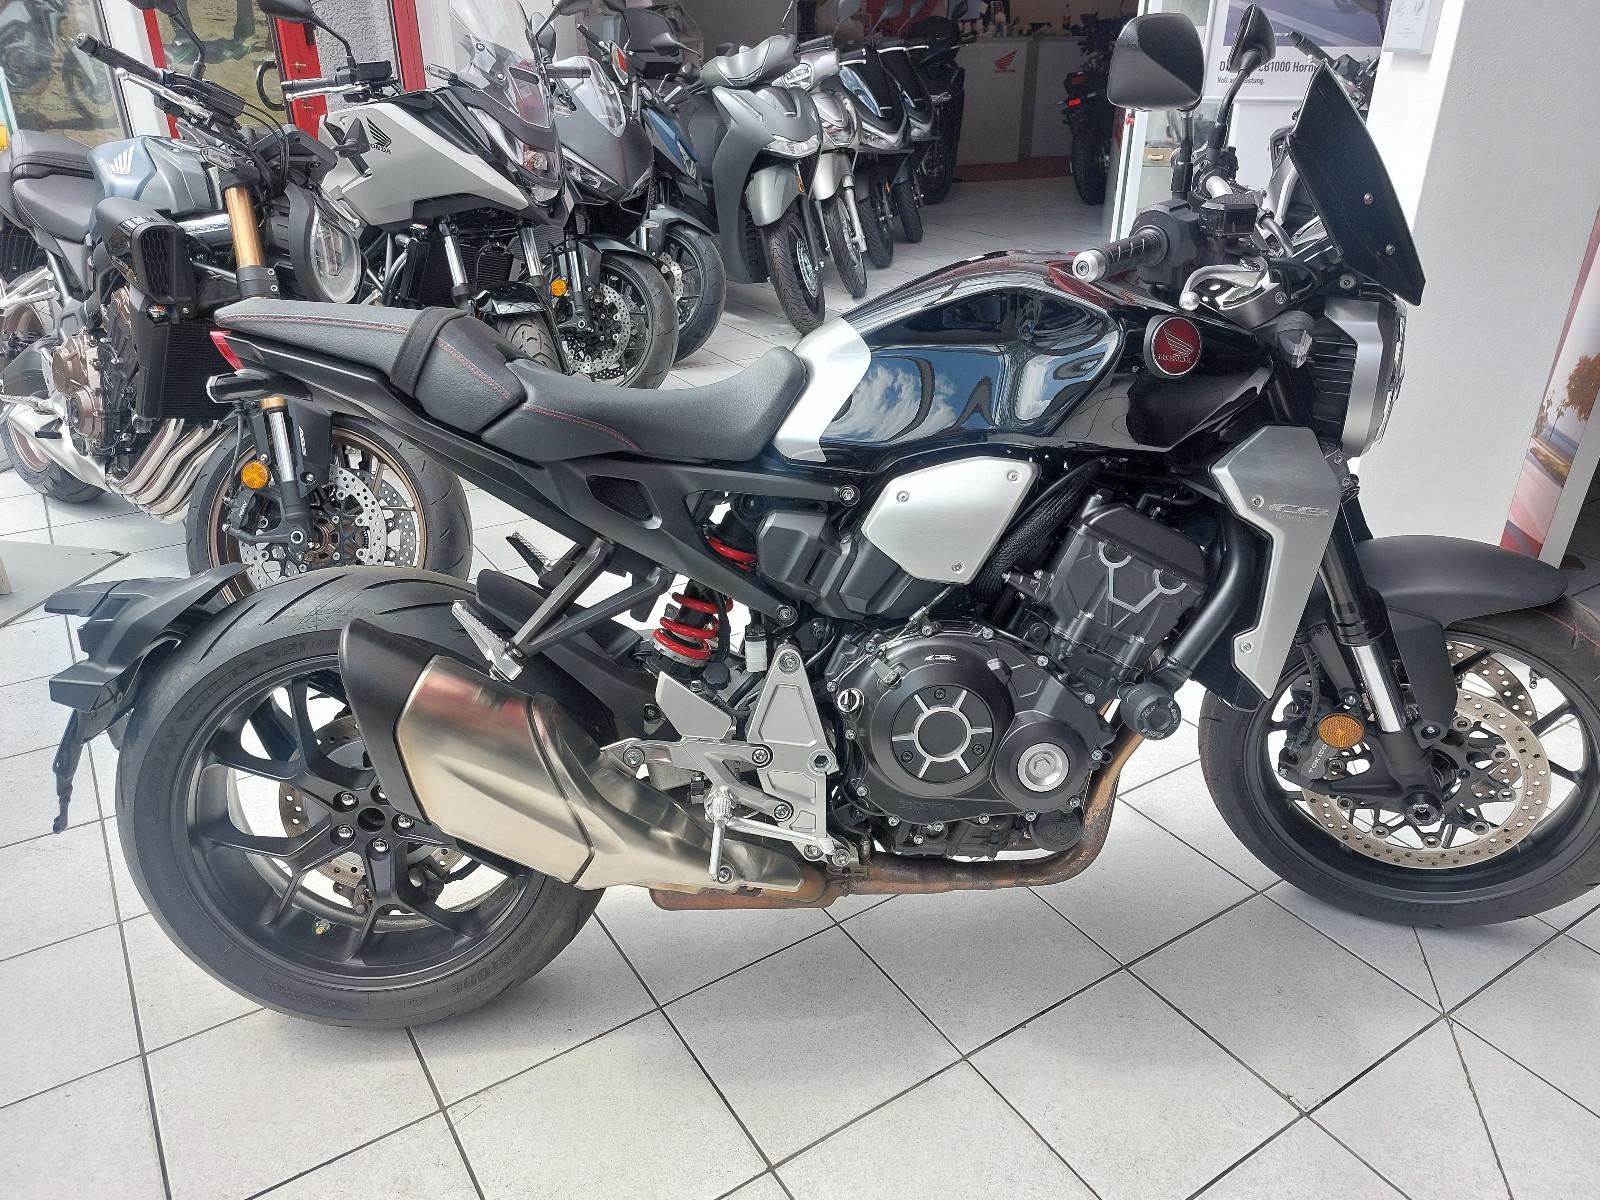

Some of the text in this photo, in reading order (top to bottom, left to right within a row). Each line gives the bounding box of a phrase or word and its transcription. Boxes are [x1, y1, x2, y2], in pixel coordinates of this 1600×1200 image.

[369, 142, 392, 155] ONDA
[1157, 353, 1193, 364] HONDA
[1307, 743, 1328, 774] TOKICO
